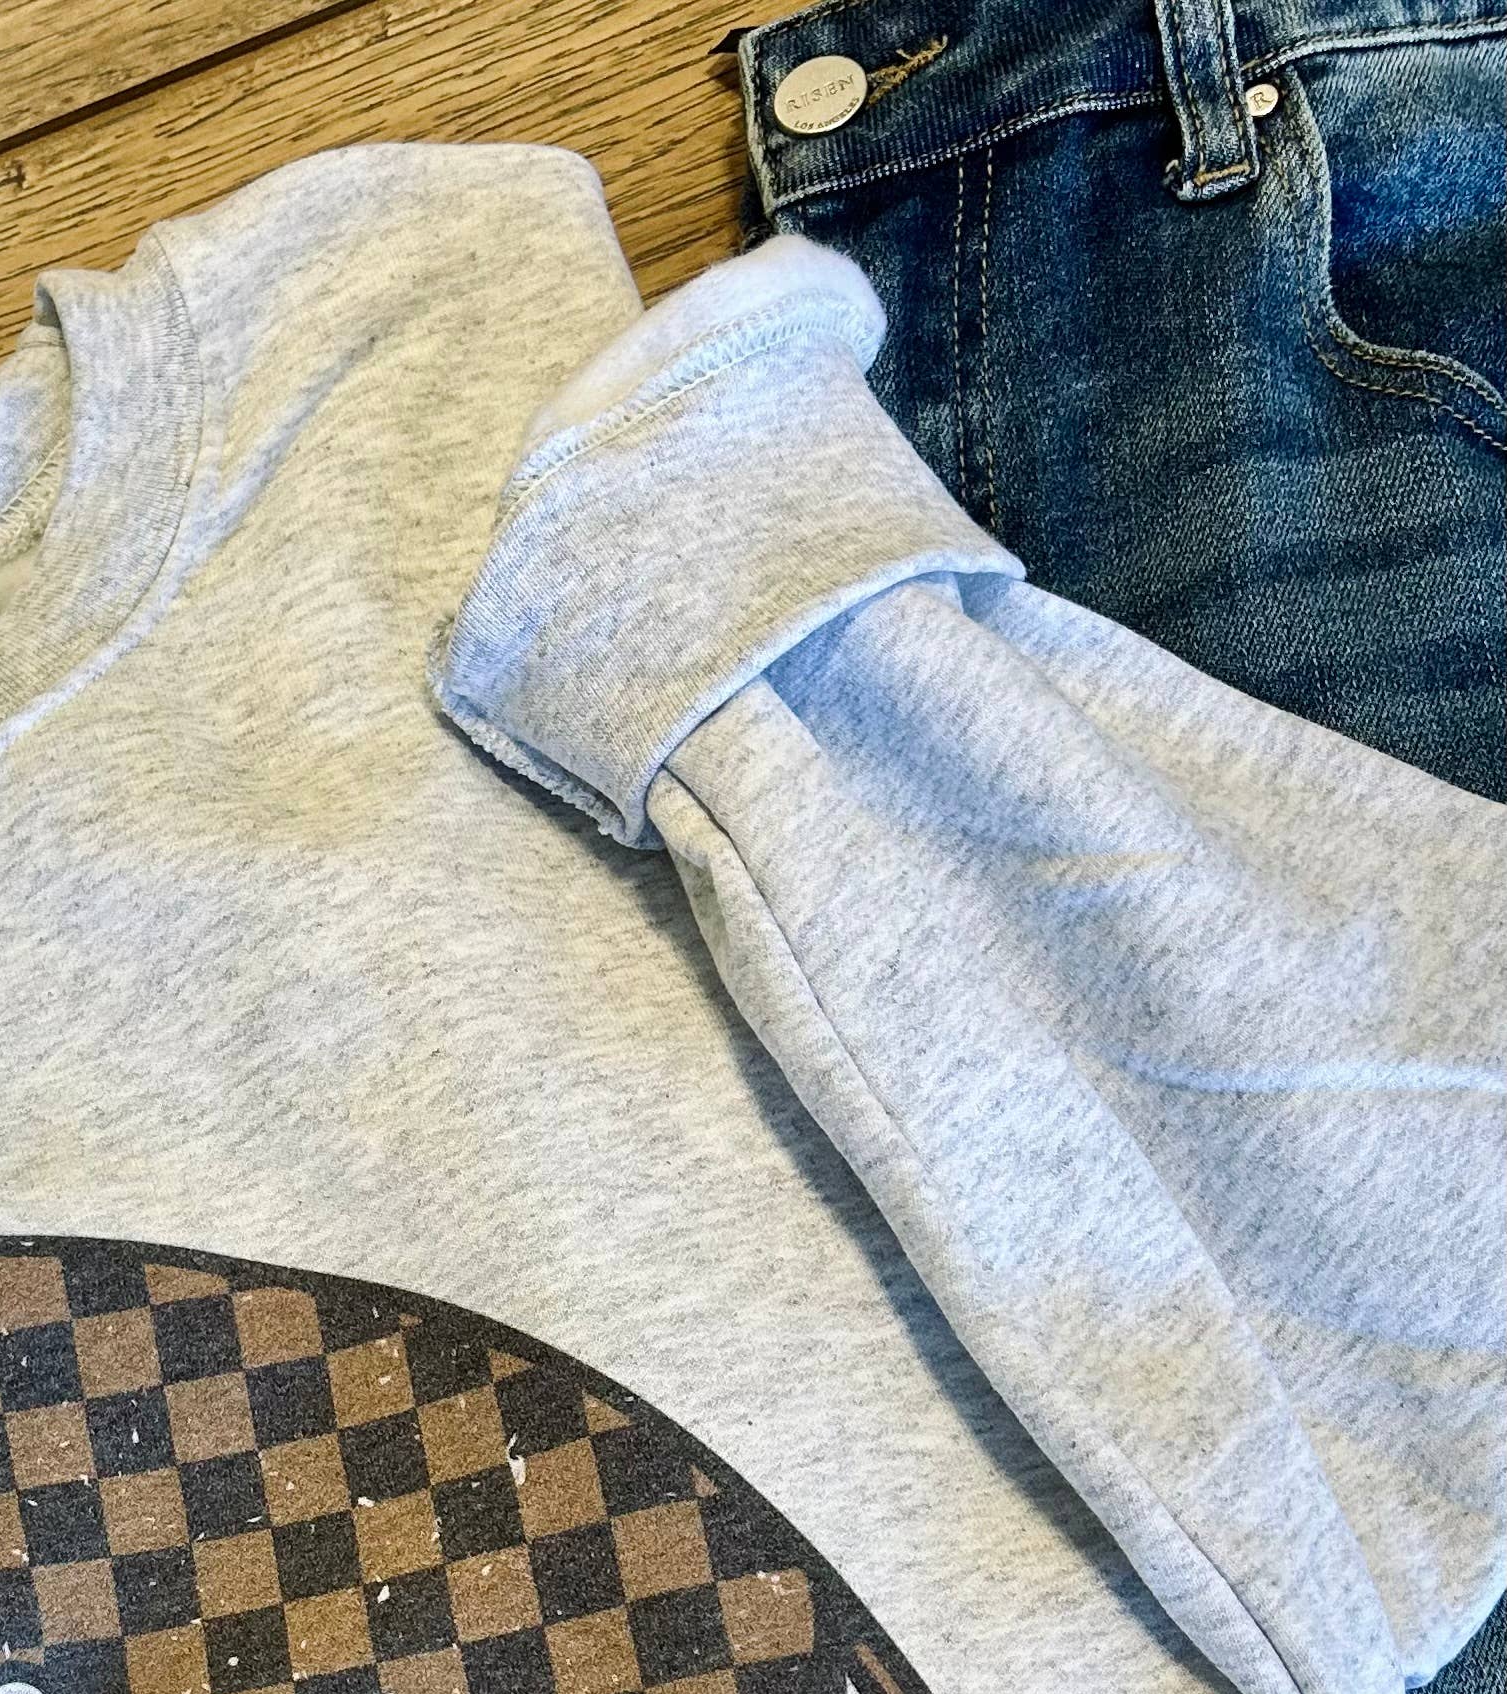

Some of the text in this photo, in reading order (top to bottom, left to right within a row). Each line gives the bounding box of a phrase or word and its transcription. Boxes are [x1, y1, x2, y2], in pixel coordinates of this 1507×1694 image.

[784, 73, 855, 113] RISEN
[1249, 91, 1275, 110] R
[794, 96, 860, 130] LOS ANGELES
